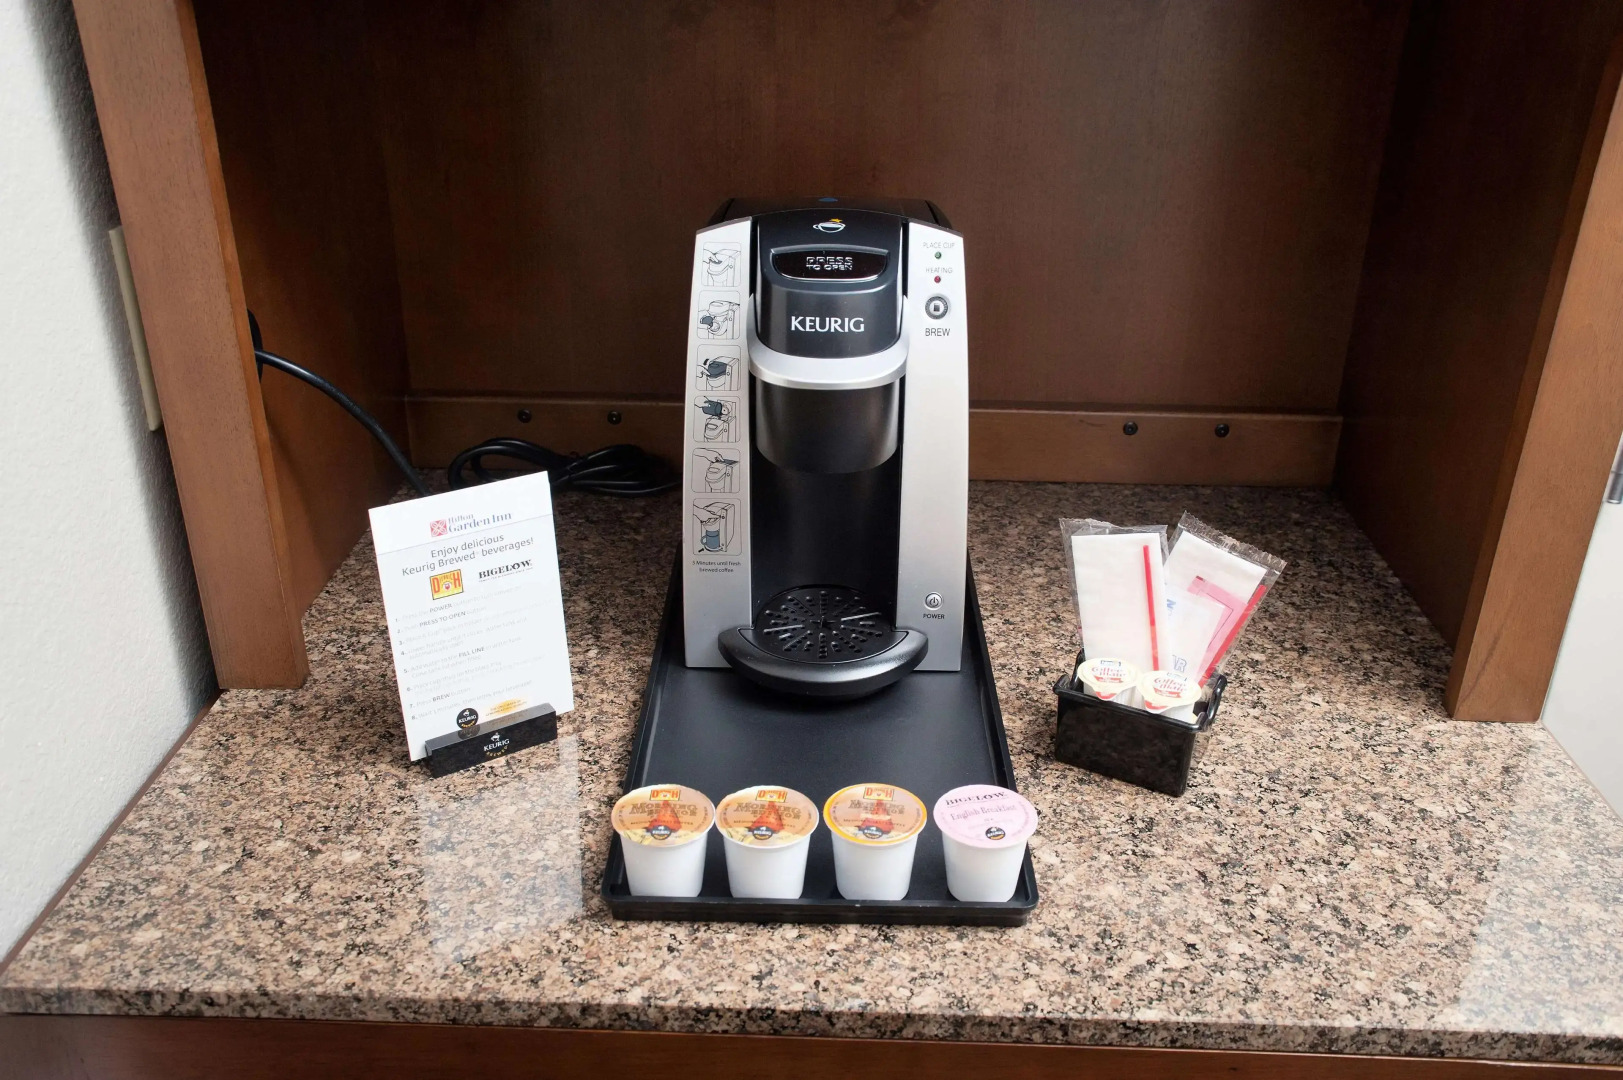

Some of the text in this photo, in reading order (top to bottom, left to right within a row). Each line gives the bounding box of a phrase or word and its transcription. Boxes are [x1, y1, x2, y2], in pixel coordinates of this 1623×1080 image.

[806, 256, 853, 265] PRESS
[925, 266, 953, 274] HEATING
[790, 315, 865, 333] KEURIG
[925, 328, 951, 337] BREW
[448, 512, 512, 533] Garden Inn
[430, 534, 505, 558] Enjoy delicious
[402, 536, 534, 577] Keurig Brewed beverages!
[478, 558, 532, 579] BIGELOW
[429, 603, 453, 613] POWER
[419, 618, 439, 627] PRESS
[439, 615, 448, 623] TO
[448, 610, 466, 620] OPEN
[483, 738, 510, 752] KEURIG
[945, 791, 1006, 806] BIGELOW
[950, 807, 980, 821] English
[981, 803, 1017, 814] Breakfast
